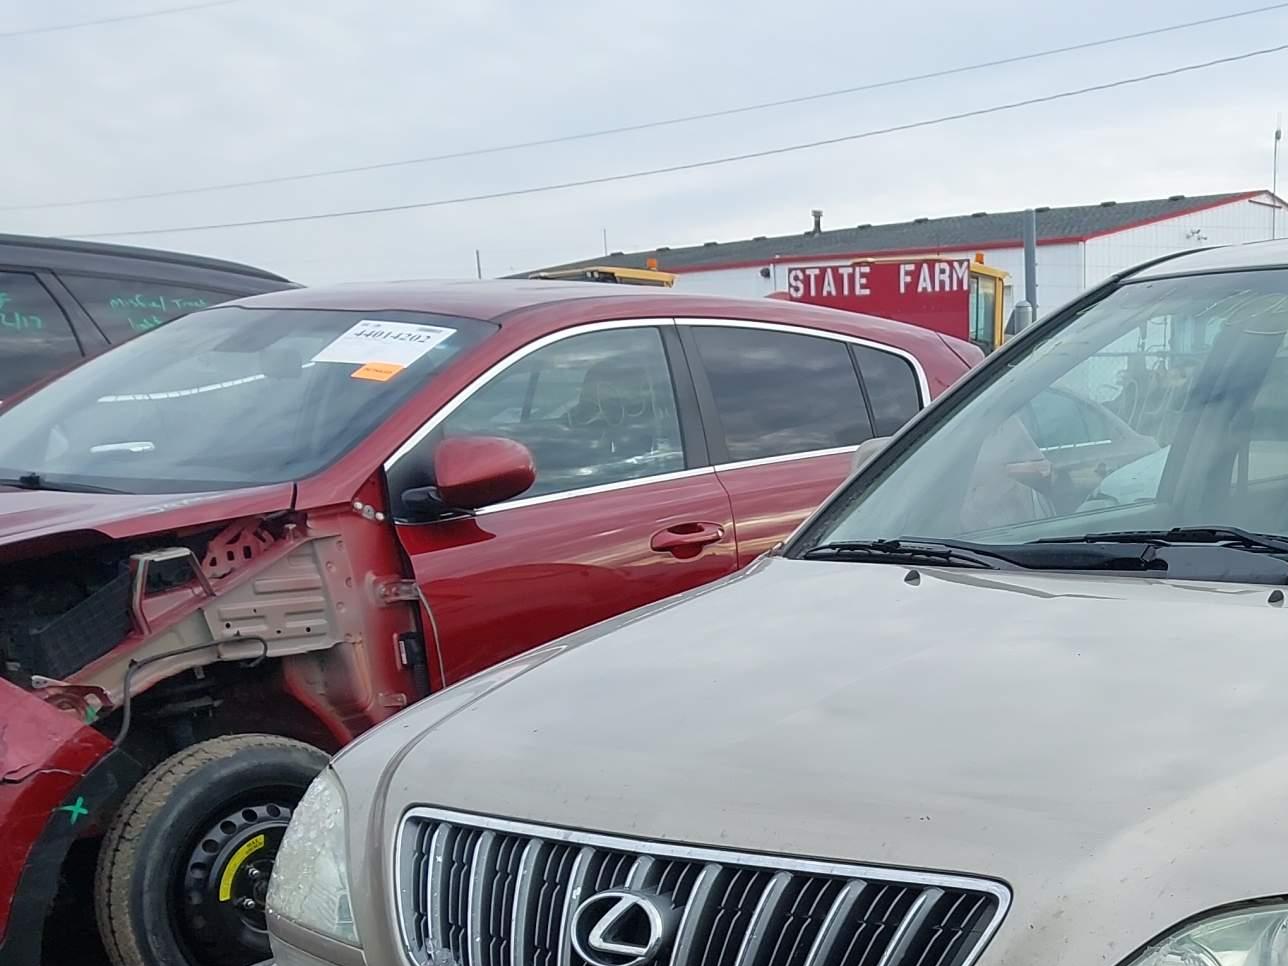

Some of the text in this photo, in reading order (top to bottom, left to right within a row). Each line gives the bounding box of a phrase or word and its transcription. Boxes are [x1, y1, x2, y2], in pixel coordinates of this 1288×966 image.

[789, 260, 969, 299] STATE FARM
[354, 328, 432, 343] 44014202
